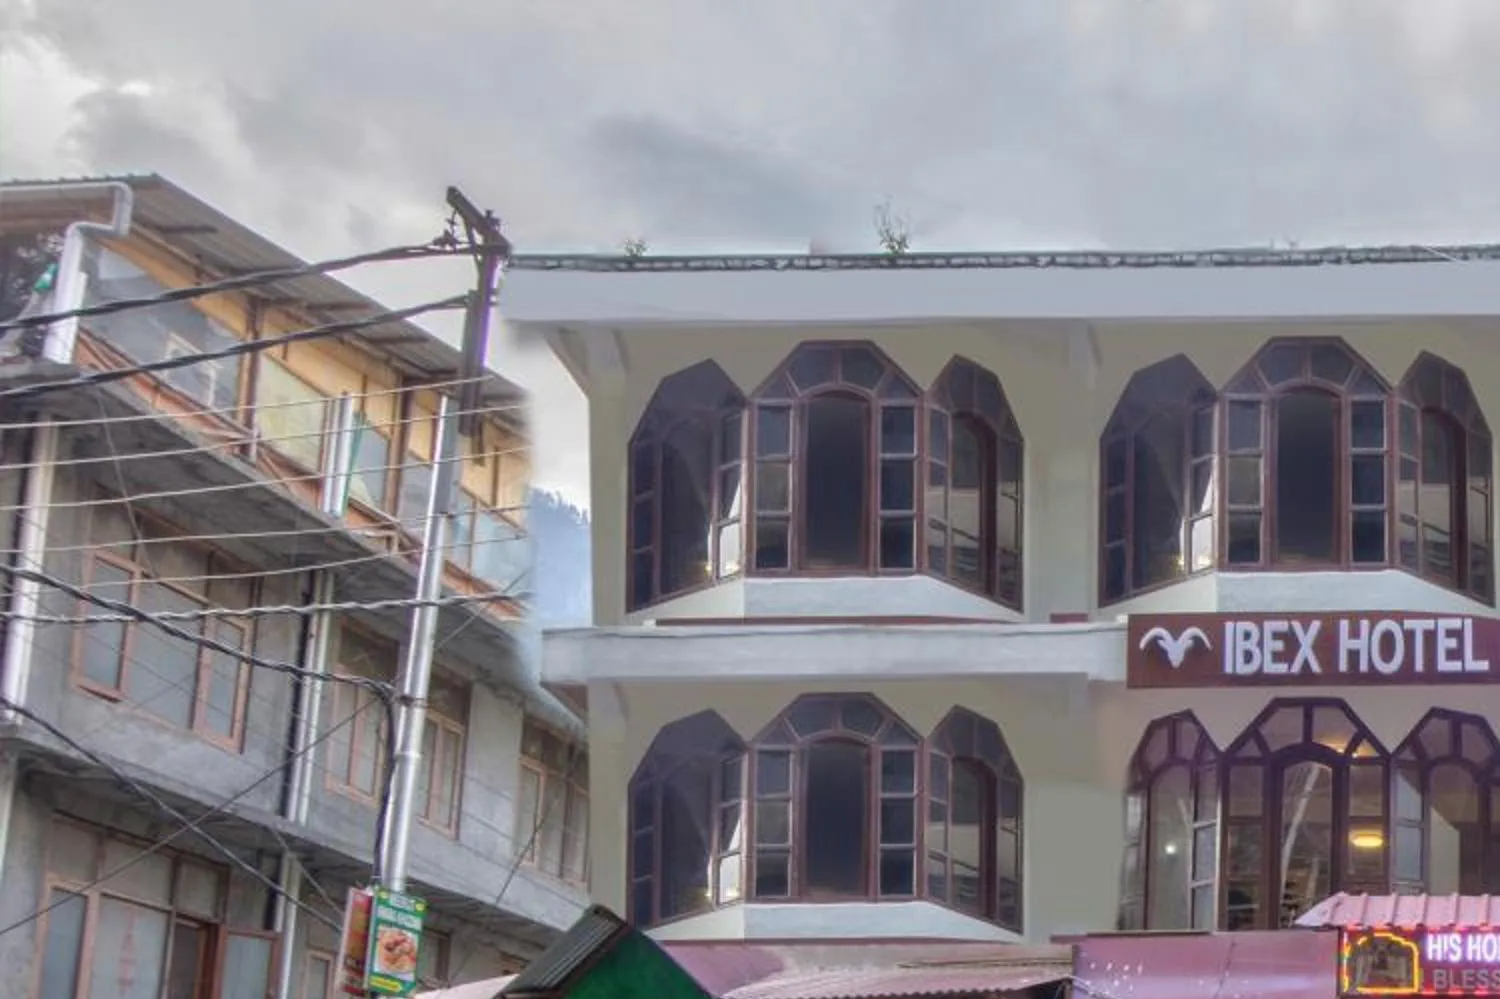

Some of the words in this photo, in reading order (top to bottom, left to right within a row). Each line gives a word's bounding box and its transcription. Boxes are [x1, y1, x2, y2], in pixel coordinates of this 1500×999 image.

[1223, 620, 1323, 675] IBEX
[1337, 617, 1490, 674] HOTEL
[1427, 933, 1462, 962] HIS
